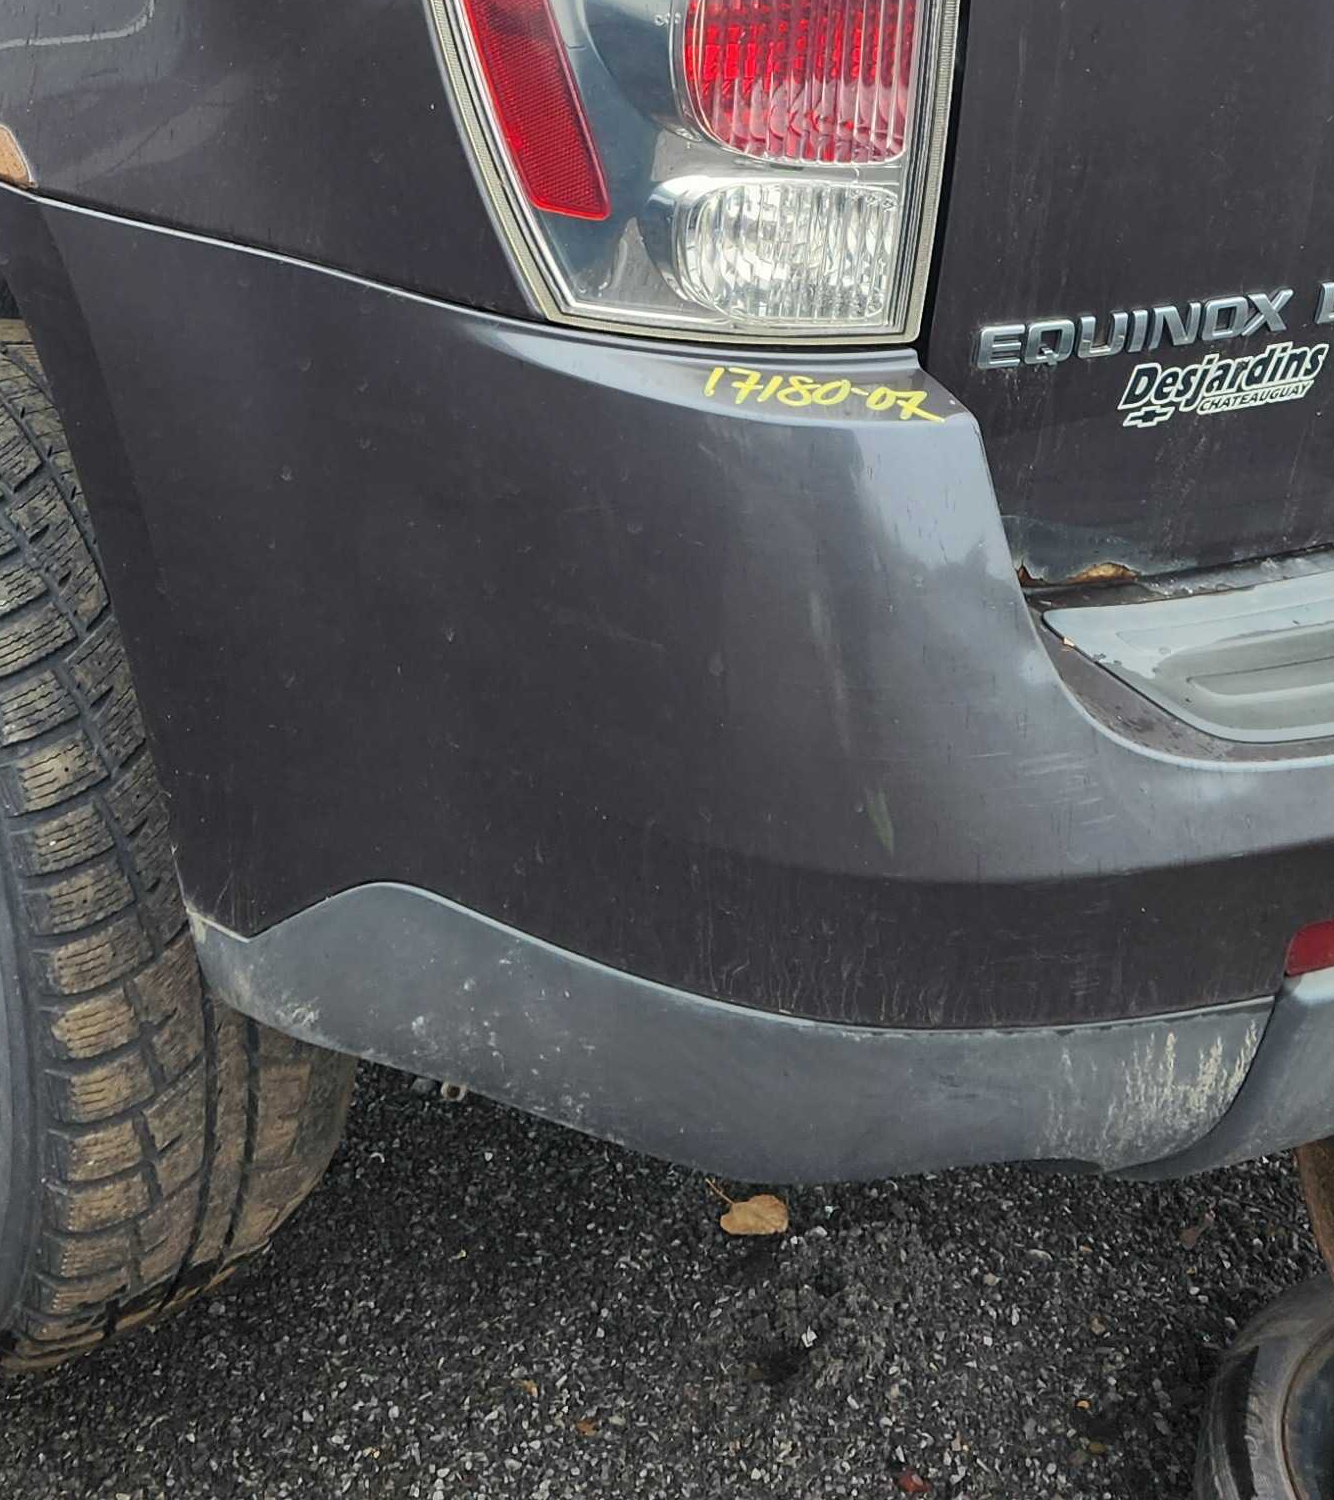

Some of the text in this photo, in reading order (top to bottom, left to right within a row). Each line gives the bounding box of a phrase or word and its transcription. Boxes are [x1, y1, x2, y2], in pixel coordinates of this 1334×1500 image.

[975, 287, 1294, 370] EQUINOX
[703, 366, 946, 423] 17180-07
[1119, 342, 1329, 412] Desjardins
[1198, 380, 1314, 414] CHATEAUGUAY
